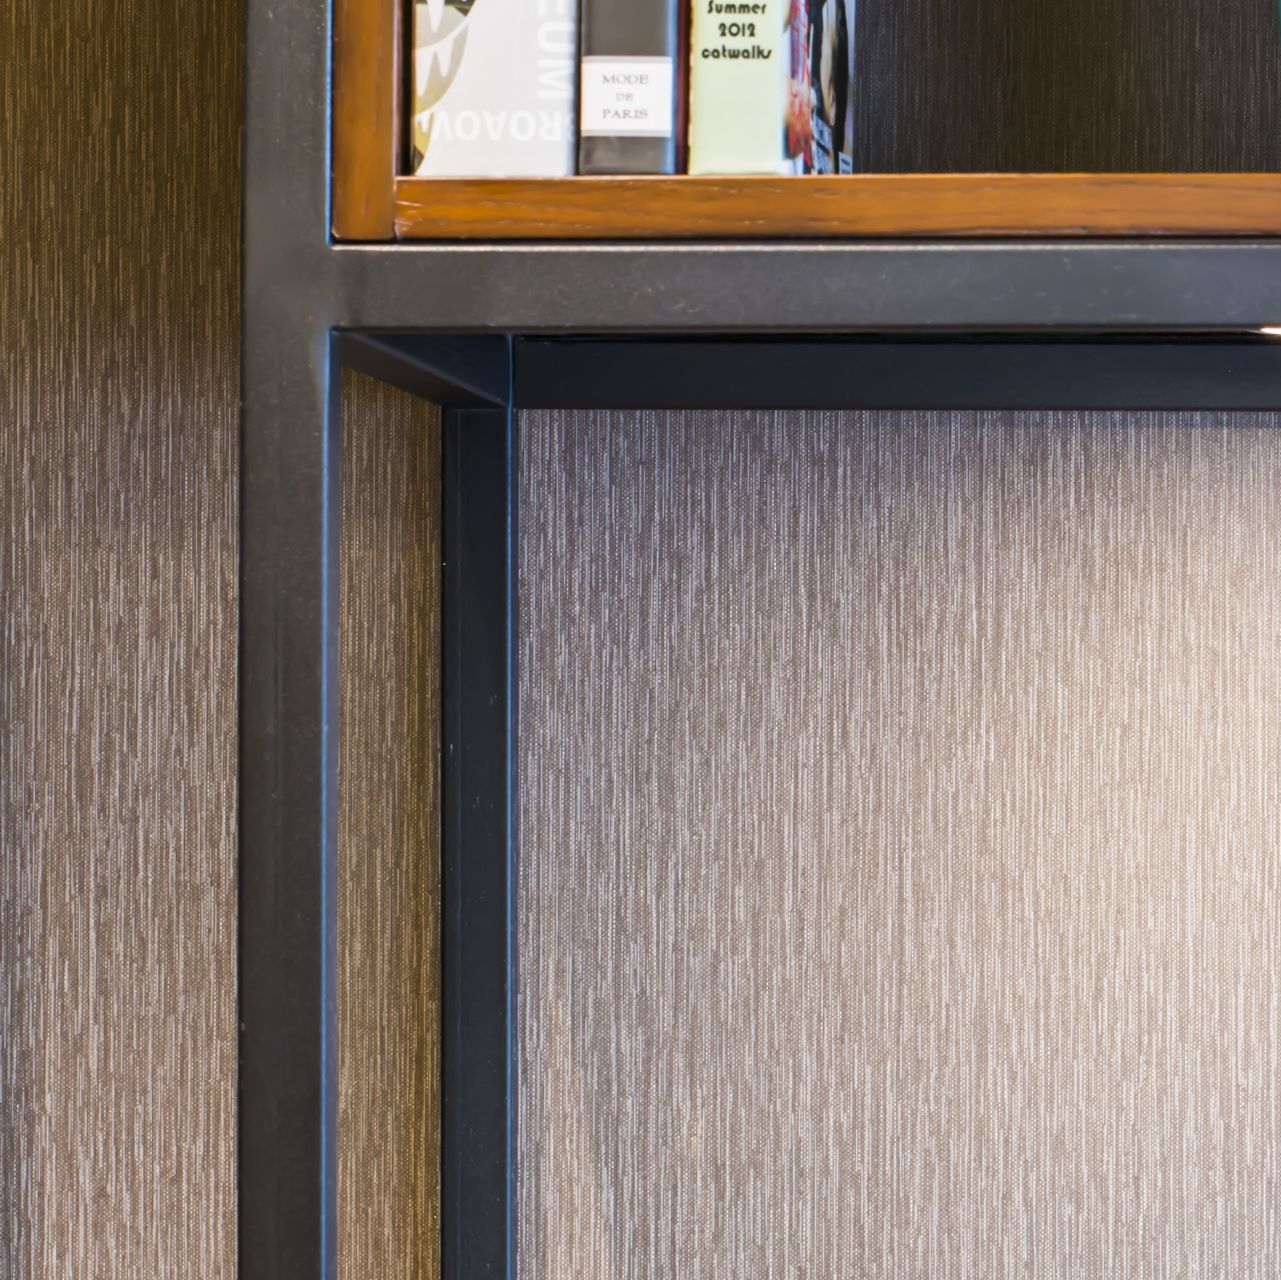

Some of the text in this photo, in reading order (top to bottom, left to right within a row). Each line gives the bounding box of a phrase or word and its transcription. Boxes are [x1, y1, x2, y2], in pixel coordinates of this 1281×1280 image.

[707, 0, 767, 15] Summer
[718, 22, 756, 37] 2012
[701, 44, 772, 60] catwalks
[602, 73, 649, 85] MODE
[616, 92, 634, 102] DE
[602, 108, 649, 119] PARIS
